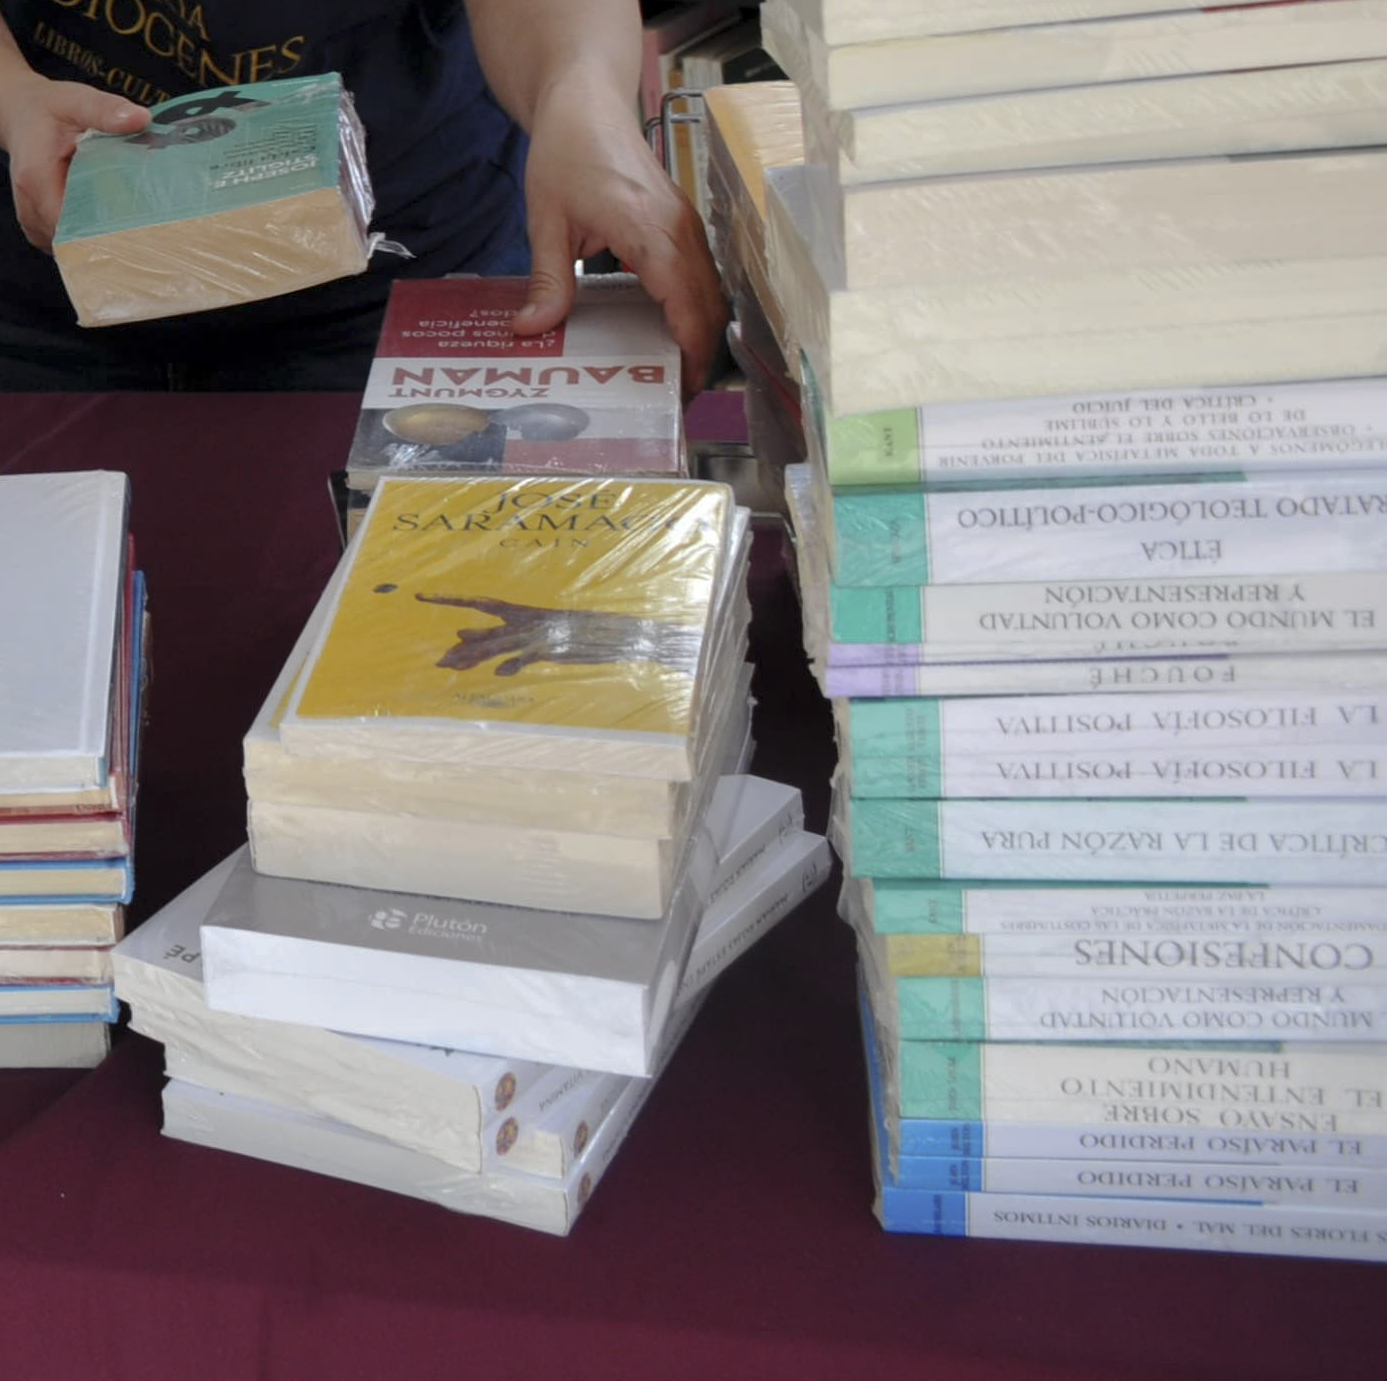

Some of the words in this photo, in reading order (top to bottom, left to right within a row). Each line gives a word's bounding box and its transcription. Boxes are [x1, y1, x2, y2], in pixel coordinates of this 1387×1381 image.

[402, 329, 465, 339] pocos
[438, 338, 514, 349] riqueza
[521, 339, 555, 349] ¿La
[391, 366, 665, 385] BAUMAN
[389, 387, 549, 398] ZYGMUNT
[1072, 397, 1132, 415] JUICIO
[1141, 397, 1174, 413] DEL
[1182, 394, 1256, 414] CRÍTICA
[1043, 418, 1120, 433] SUBLIME
[1182, 412, 1238, 427] BELLO
[1283, 410, 1306, 424] DE
[1135, 430, 1199, 444] SOBRE
[1208, 423, 1355, 442] OBSERVACIONES
[938, 452, 1024, 469] PORVENIR
[1034, 450, 1067, 464] DEL
[1190, 444, 1236, 458] TODA
[497, 490, 618, 514] JOSÉ
[957, 498, 1267, 531] TEOLÓGICO-POLÍTICO
[1139, 538, 1224, 562] ÉTICA
[1044, 584, 1280, 607] REPRESENTACIÓN
[1293, 583, 1306, 603] Y
[978, 612, 1123, 632] VOLUNTAD
[1130, 610, 1217, 630] COMO
[1226, 609, 1333, 629] MUNDO
[1342, 608, 1375, 628] EL
[1086, 666, 1236, 688] FOUCHÉ
[995, 712, 1132, 735] POSITIVA
[1151, 706, 1317, 736] FILOSOFÍA
[1336, 704, 1377, 727] LA
[995, 760, 1132, 782] POSITIVA
[1151, 760, 1317, 785] FILOSOFÍA
[1336, 760, 1376, 781] LA
[980, 830, 1051, 852] PURA
[1062, 831, 1163, 856] RAZÓN
[1173, 833, 1209, 852] LA
[1219, 833, 1257, 852] DE
[1239, 906, 1257, 919] DE
[1073, 939, 1374, 972] CONFESIONES
[1101, 986, 1322, 1005] REPRESENTACIÓN
[1330, 986, 1346, 1005] Y
[1039, 1010, 1174, 1029] VOLUNTAD
[1182, 1010, 1263, 1029] COMO
[1272, 1010, 1373, 1029] MUNDO
[1148, 1056, 1290, 1079] HUMANO
[1059, 1077, 1325, 1106] ENTENDIMIENTO
[1344, 1088, 1384, 1108] EL
[1103, 1101, 1200, 1125] SOBRE
[1219, 1109, 1337, 1132] ENSAYO
[1079, 1132, 1195, 1150] PERDIDO
[1207, 1136, 1317, 1155] PARAÍSO
[1328, 1139, 1363, 1156] EL
[1077, 1170, 1192, 1190] PERDIDO
[1205, 1172, 1313, 1198] PARAÍSO
[1326, 1178, 1358, 1194] EL
[1086, 1215, 1167, 1232] DIARIOS
[1192, 1220, 1235, 1235] MAL
[1242, 1223, 1281, 1239] DEL
[1290, 1226, 1369, 1242] FLORES
